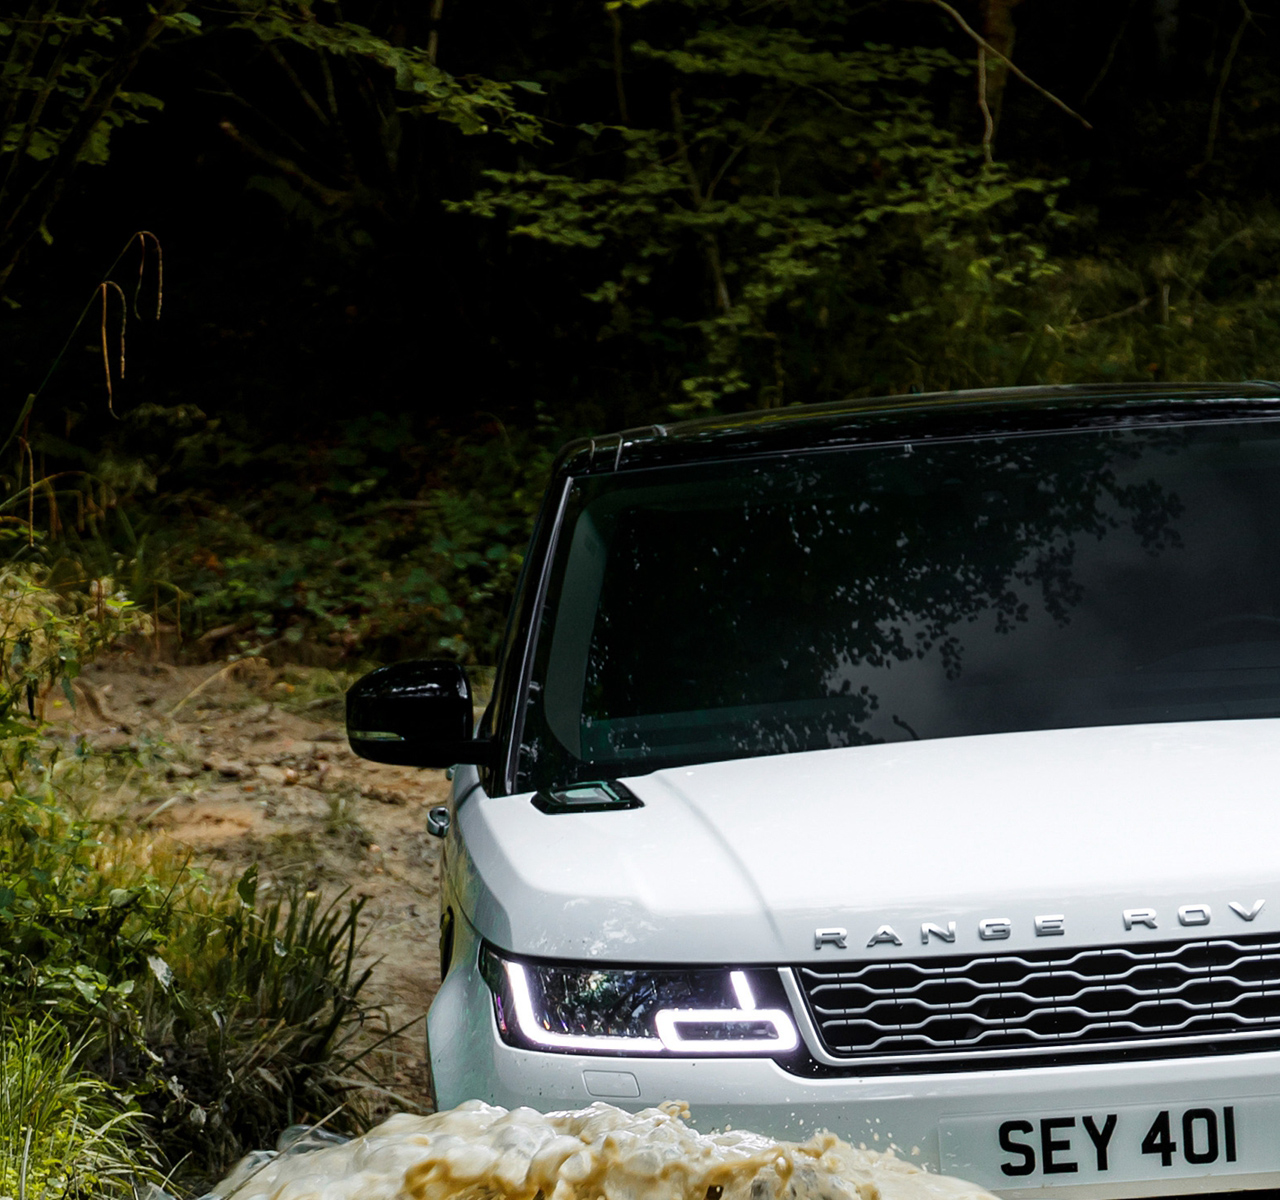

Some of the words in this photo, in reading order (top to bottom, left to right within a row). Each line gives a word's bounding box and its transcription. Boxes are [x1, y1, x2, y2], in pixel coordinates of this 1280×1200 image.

[814, 913, 1066, 951] RANGE
[998, 1113, 1118, 1177] SEY
[1140, 1105, 1237, 1167] 401
